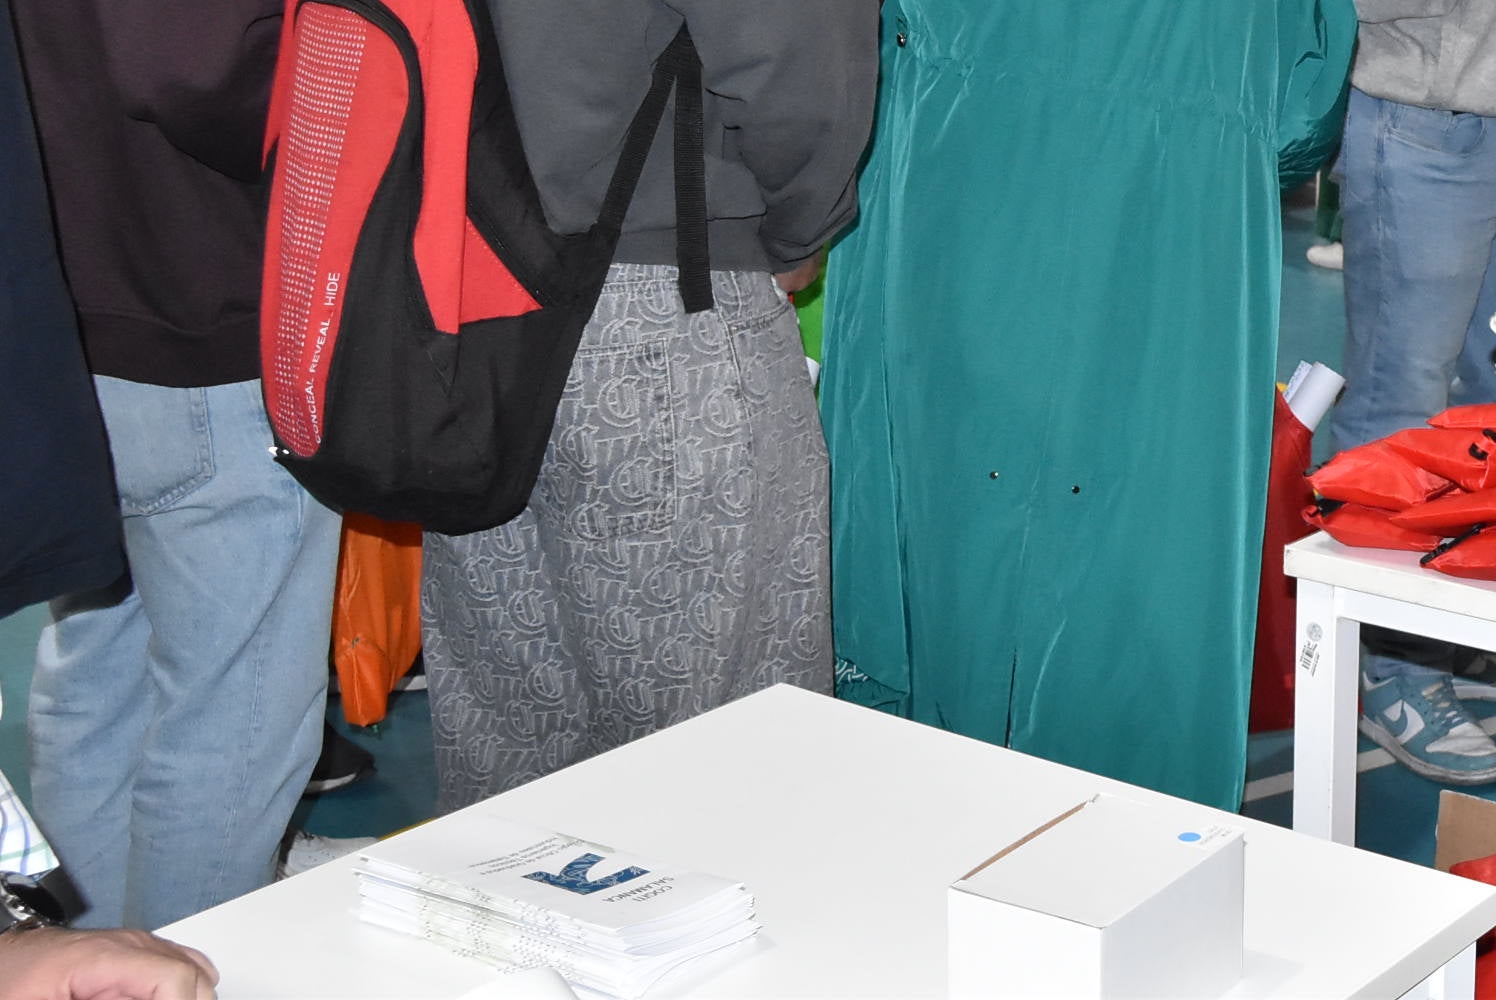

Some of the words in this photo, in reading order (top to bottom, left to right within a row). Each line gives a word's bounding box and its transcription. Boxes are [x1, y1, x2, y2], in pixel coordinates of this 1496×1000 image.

[323, 271, 341, 307] HIDE
[308, 318, 331, 373] REVEAL
[304, 377, 322, 444] CONCEAL
